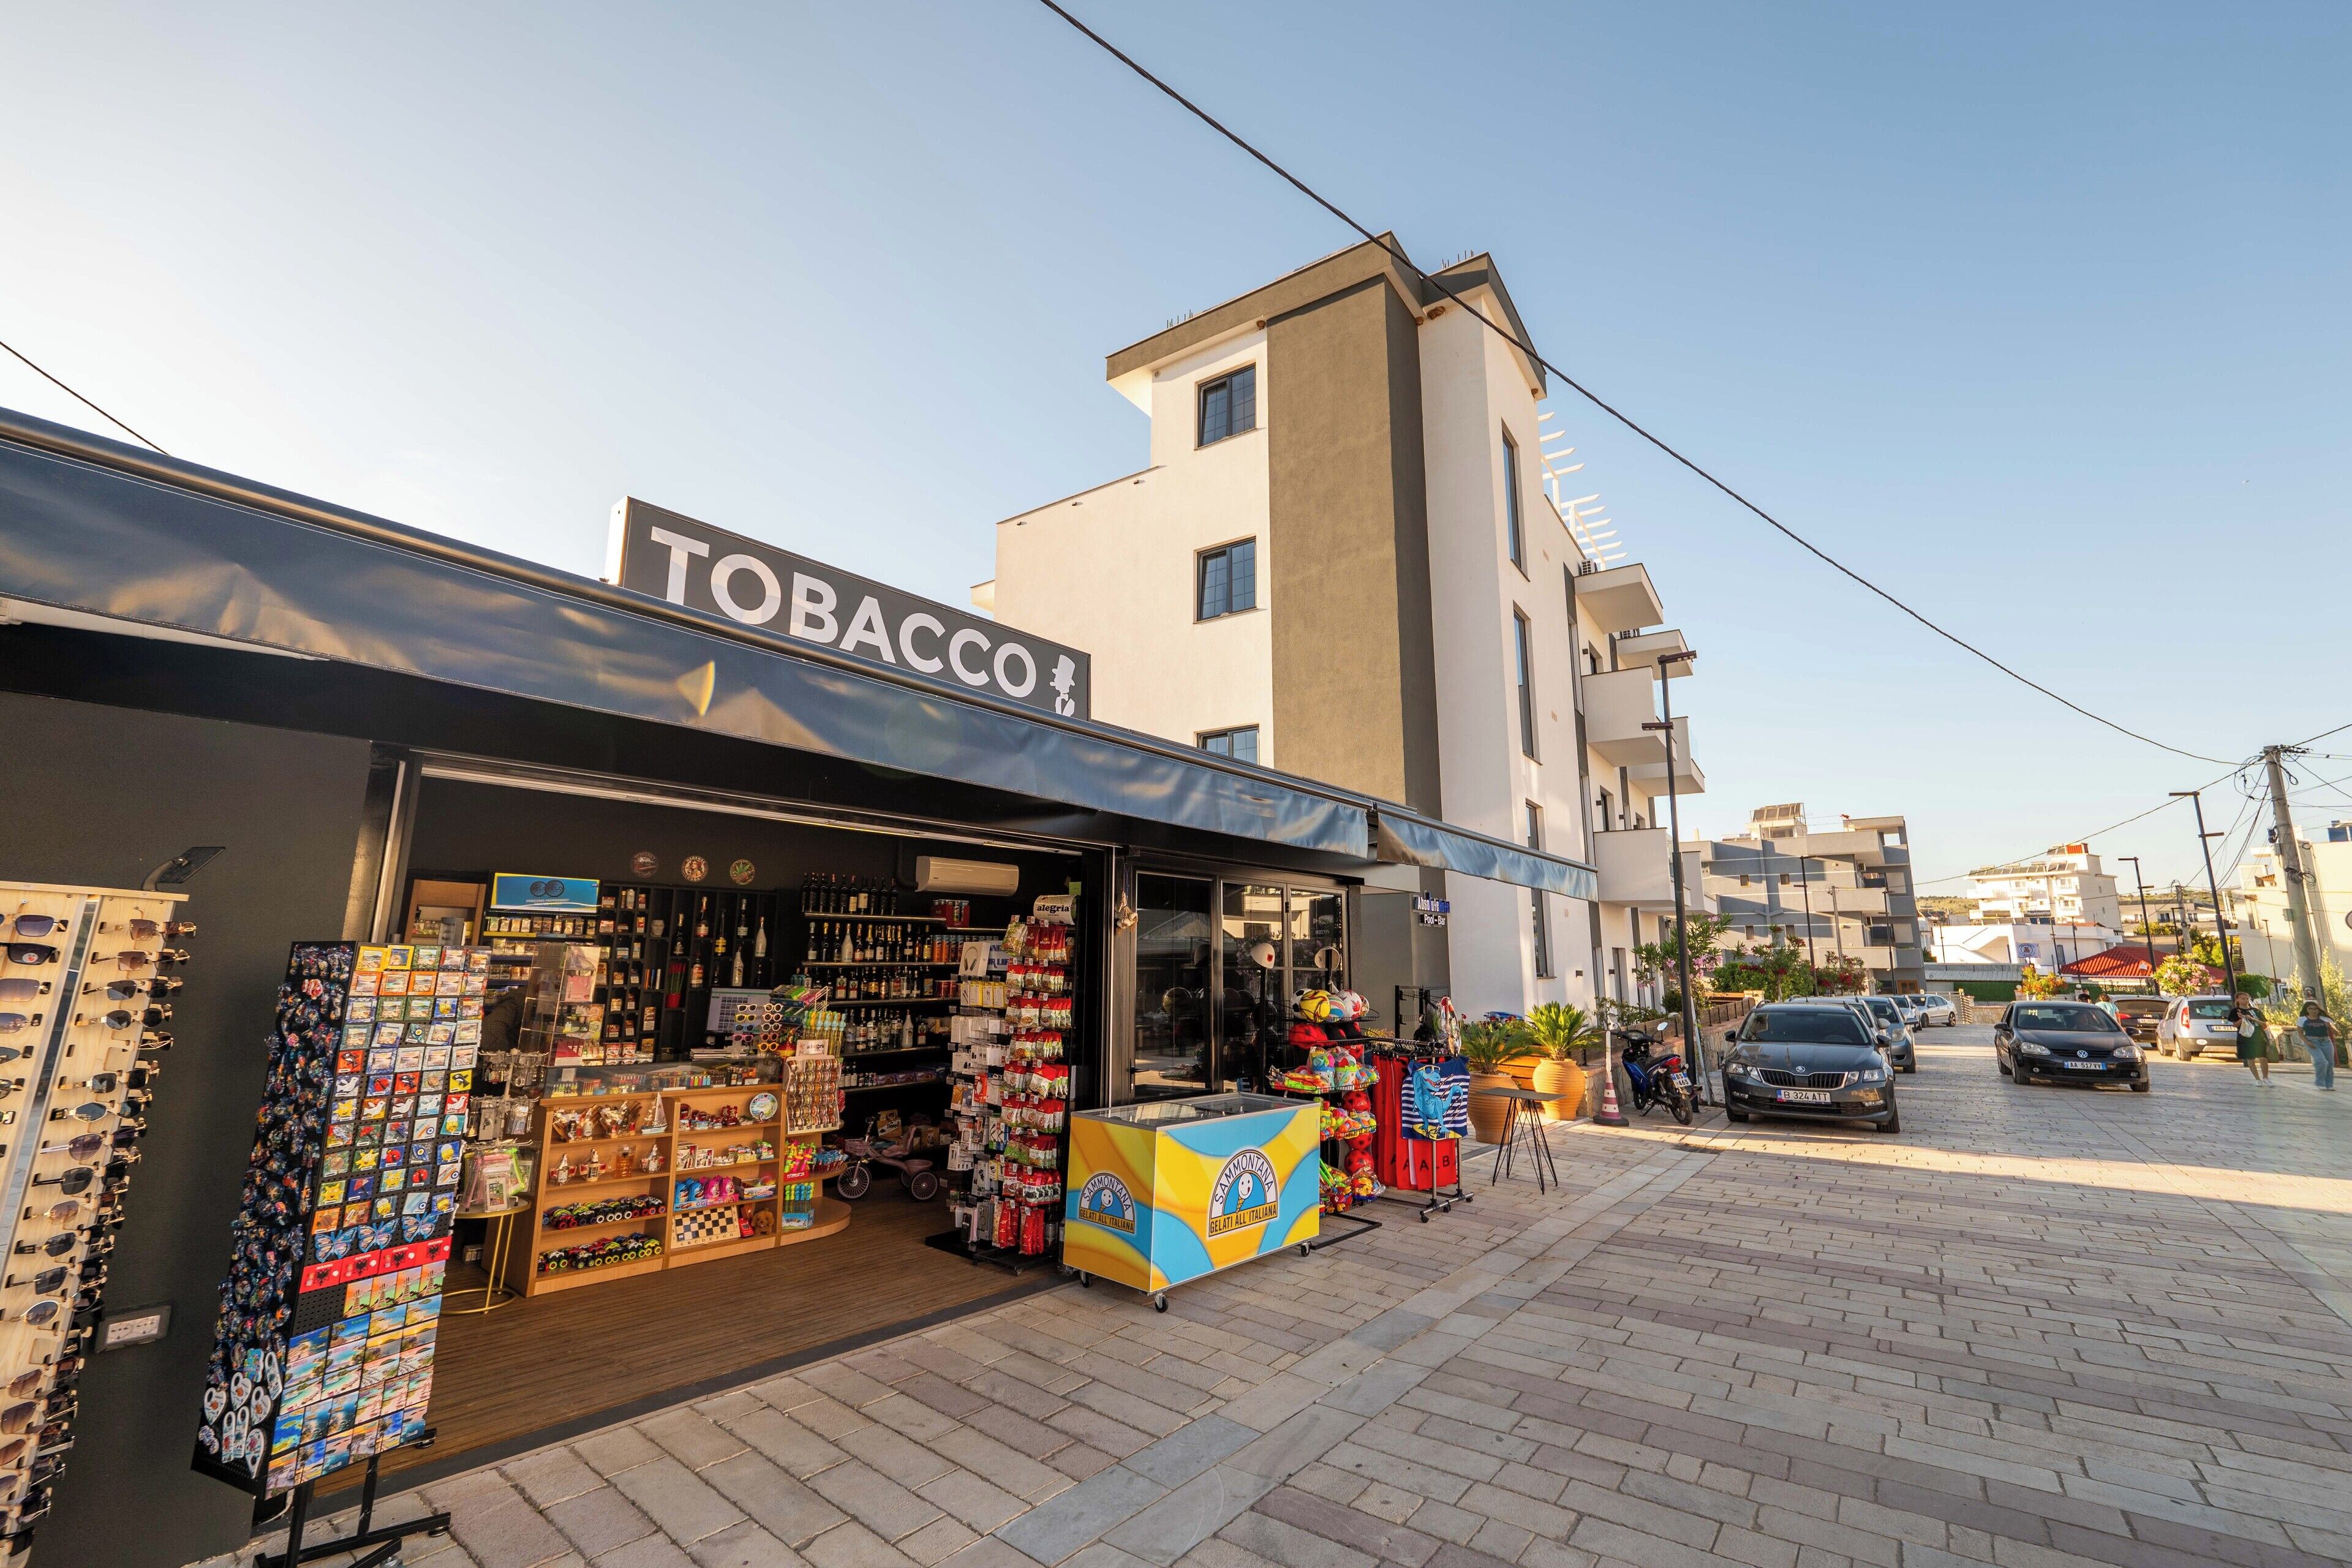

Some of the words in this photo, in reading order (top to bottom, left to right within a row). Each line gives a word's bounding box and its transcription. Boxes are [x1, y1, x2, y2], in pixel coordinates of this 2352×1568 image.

[650, 526, 1037, 698] TOBACCO
[1036, 904, 1069, 914] alegria
[1812, 1093, 1828, 1101] ATT
[1214, 1153, 1274, 1205] SAMMONTANA
[1083, 1175, 1131, 1212] SAMMONTANA
[1079, 1209, 1098, 1223] GELATI
[1210, 1218, 1234, 1235] GELATI
[1234, 1207, 1277, 1226] ALL'ITALIANA
